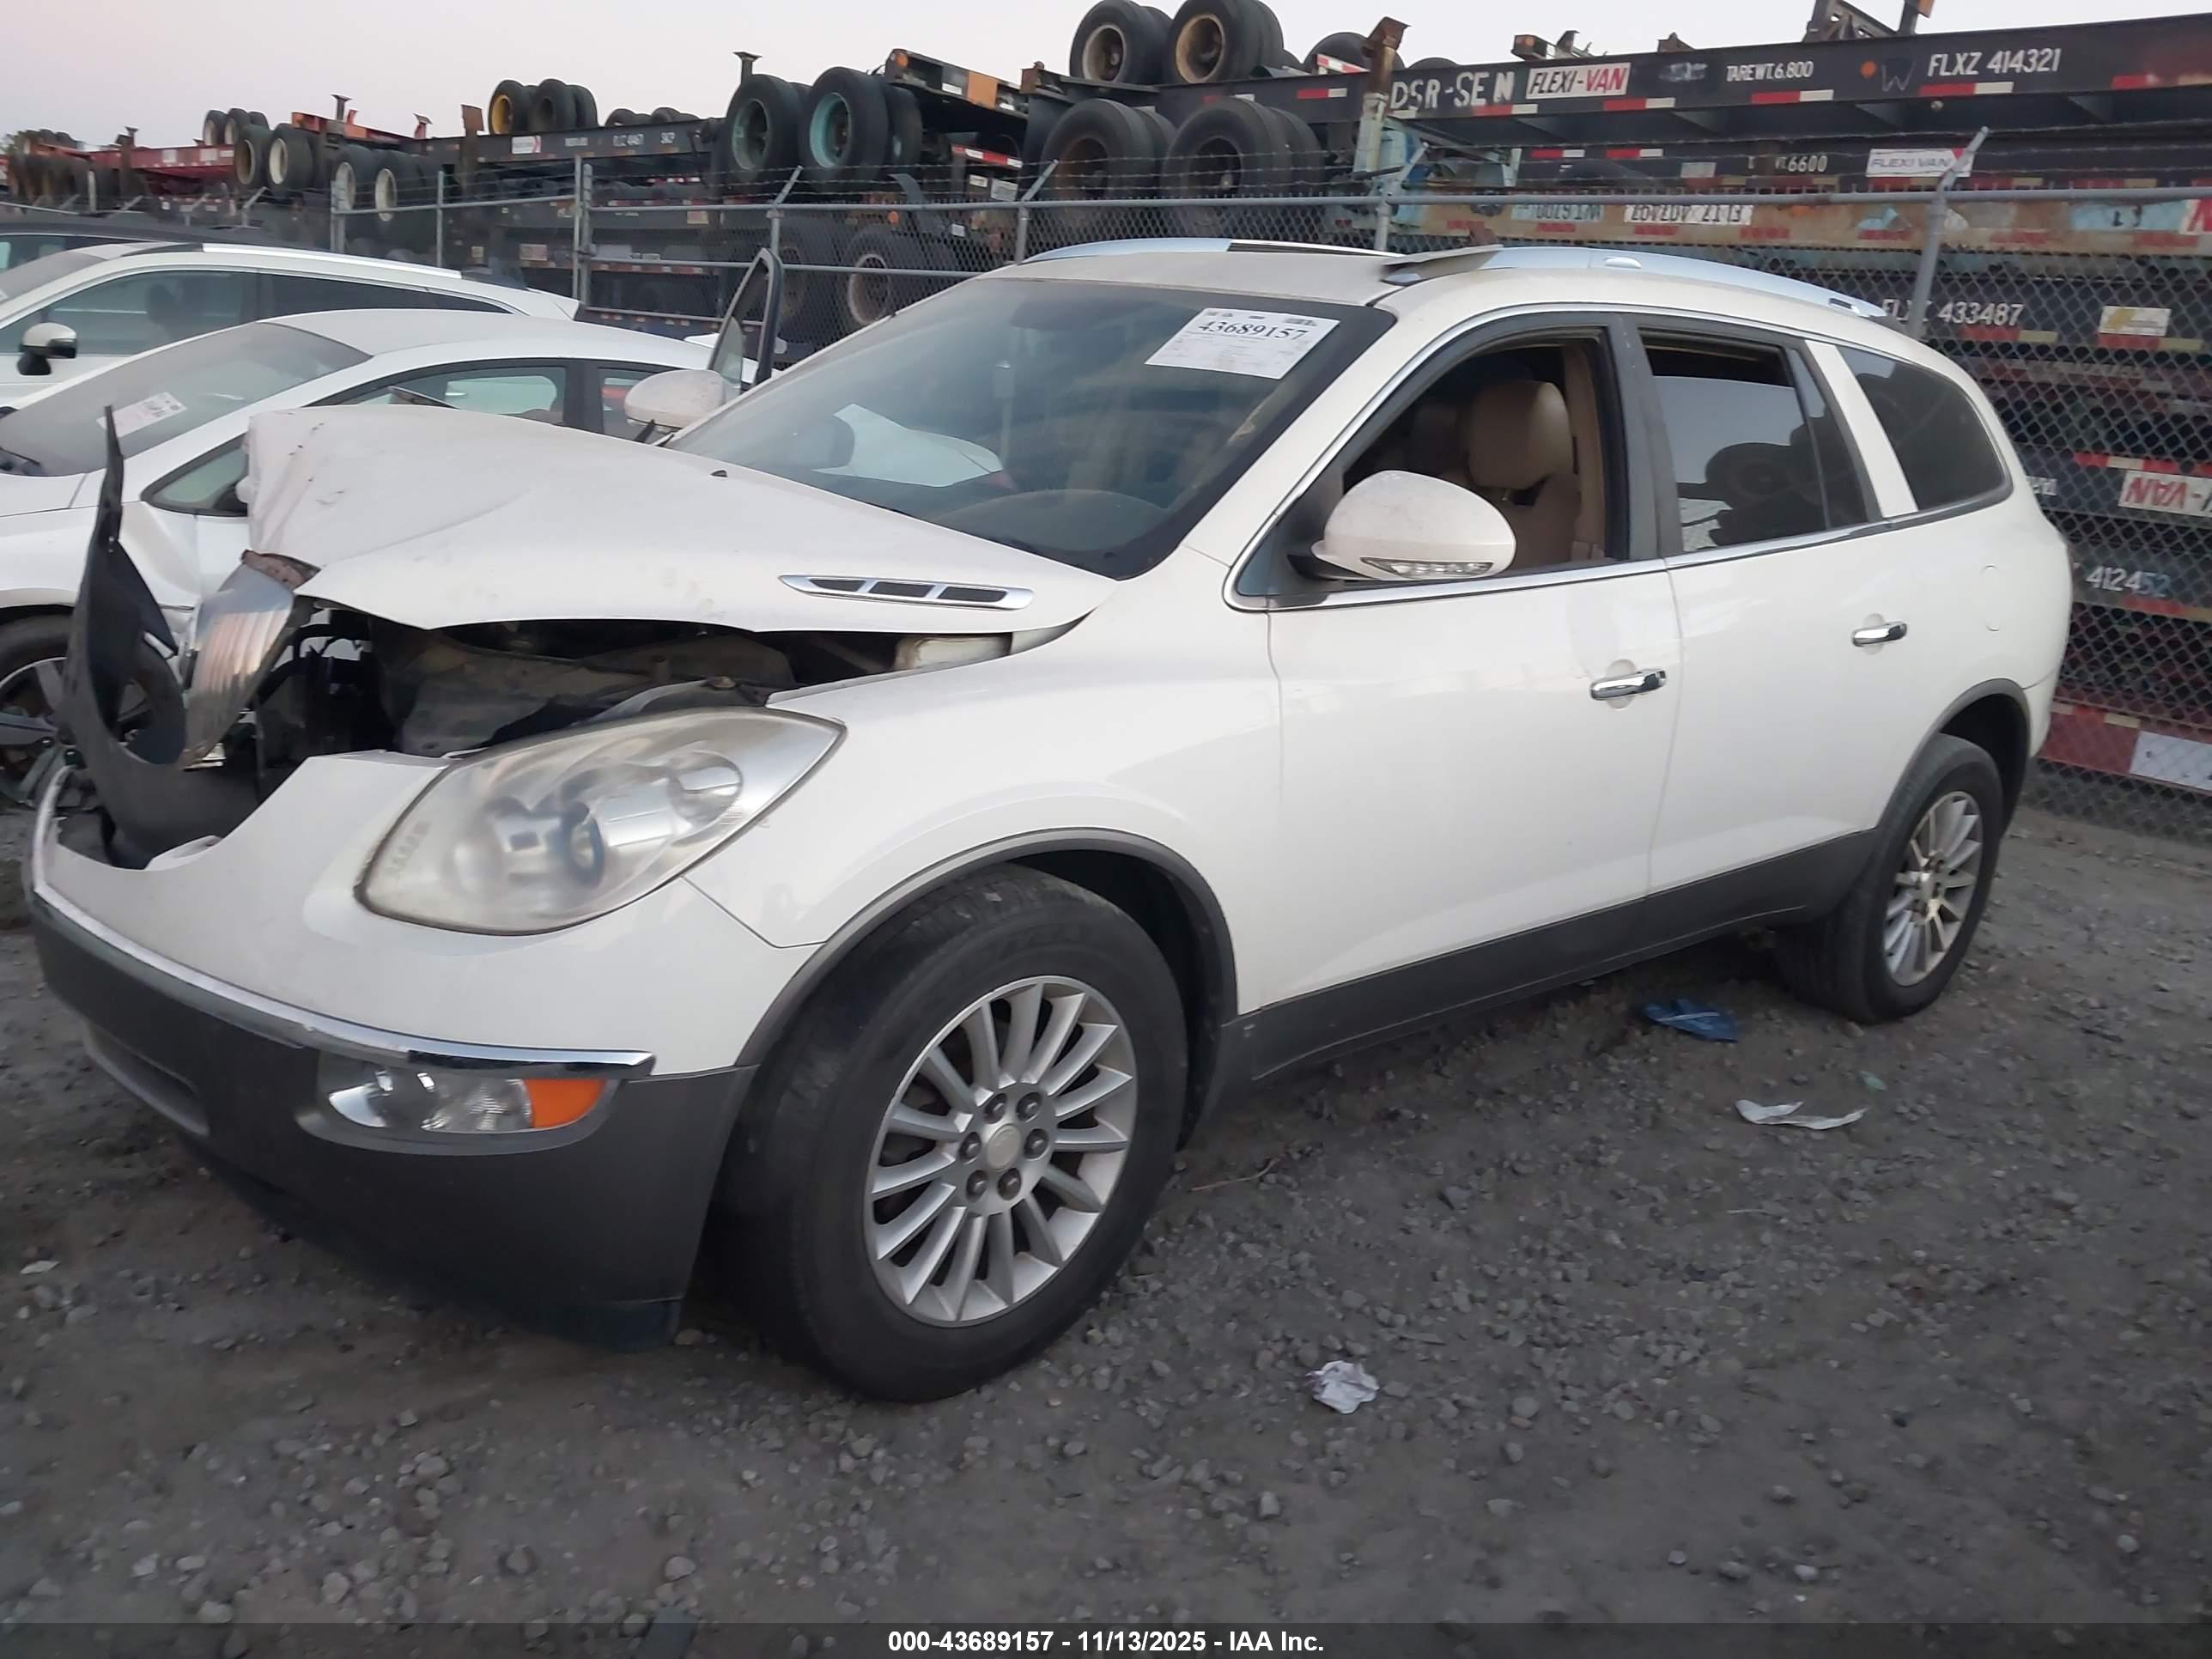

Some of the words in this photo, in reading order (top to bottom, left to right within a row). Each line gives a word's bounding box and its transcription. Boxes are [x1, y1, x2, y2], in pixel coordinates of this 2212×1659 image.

[1927, 52, 1983, 76] FLXZ
[1986, 48, 2062, 74] 414321
[1528, 68, 1626, 94] FLEXI-VAN
[1937, 301, 2024, 326] 433487
[1199, 320, 1310, 341] 43689157
